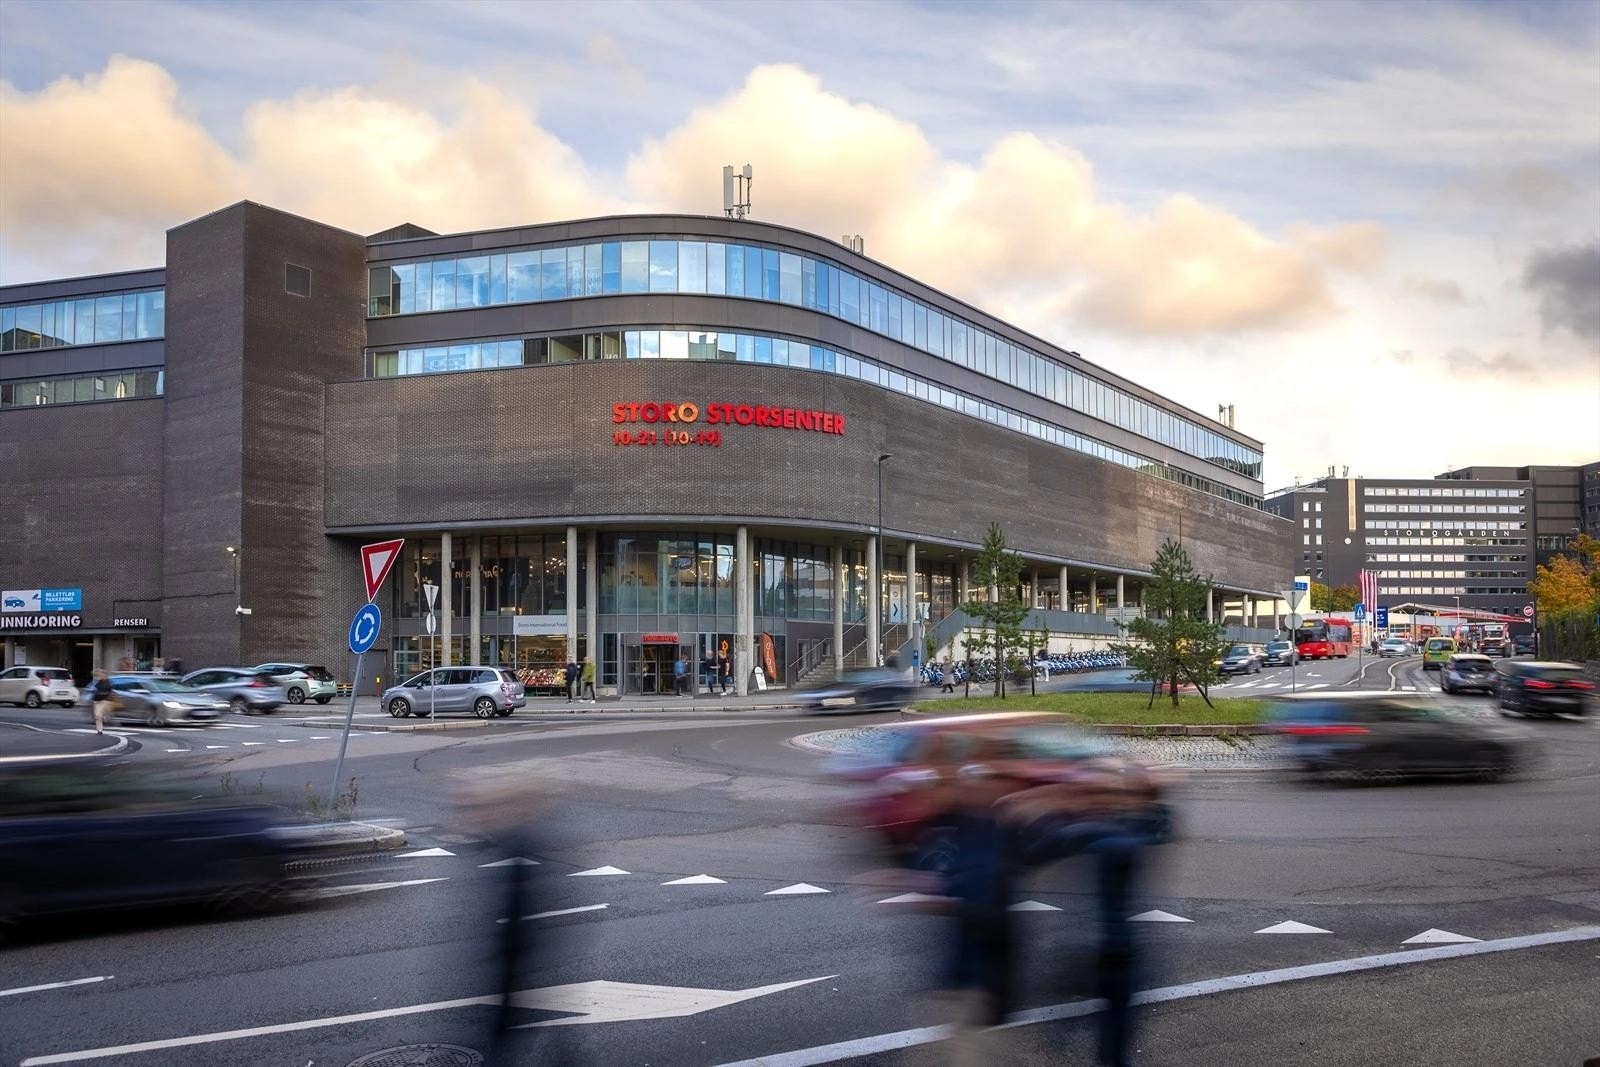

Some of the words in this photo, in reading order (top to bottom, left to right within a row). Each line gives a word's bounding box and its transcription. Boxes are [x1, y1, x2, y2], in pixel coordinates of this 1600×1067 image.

[612, 402, 699, 424] STORO
[706, 403, 846, 435] STORSENTER
[612, 430, 657, 446] 10-21
[114, 618, 147, 626] RENSERI
